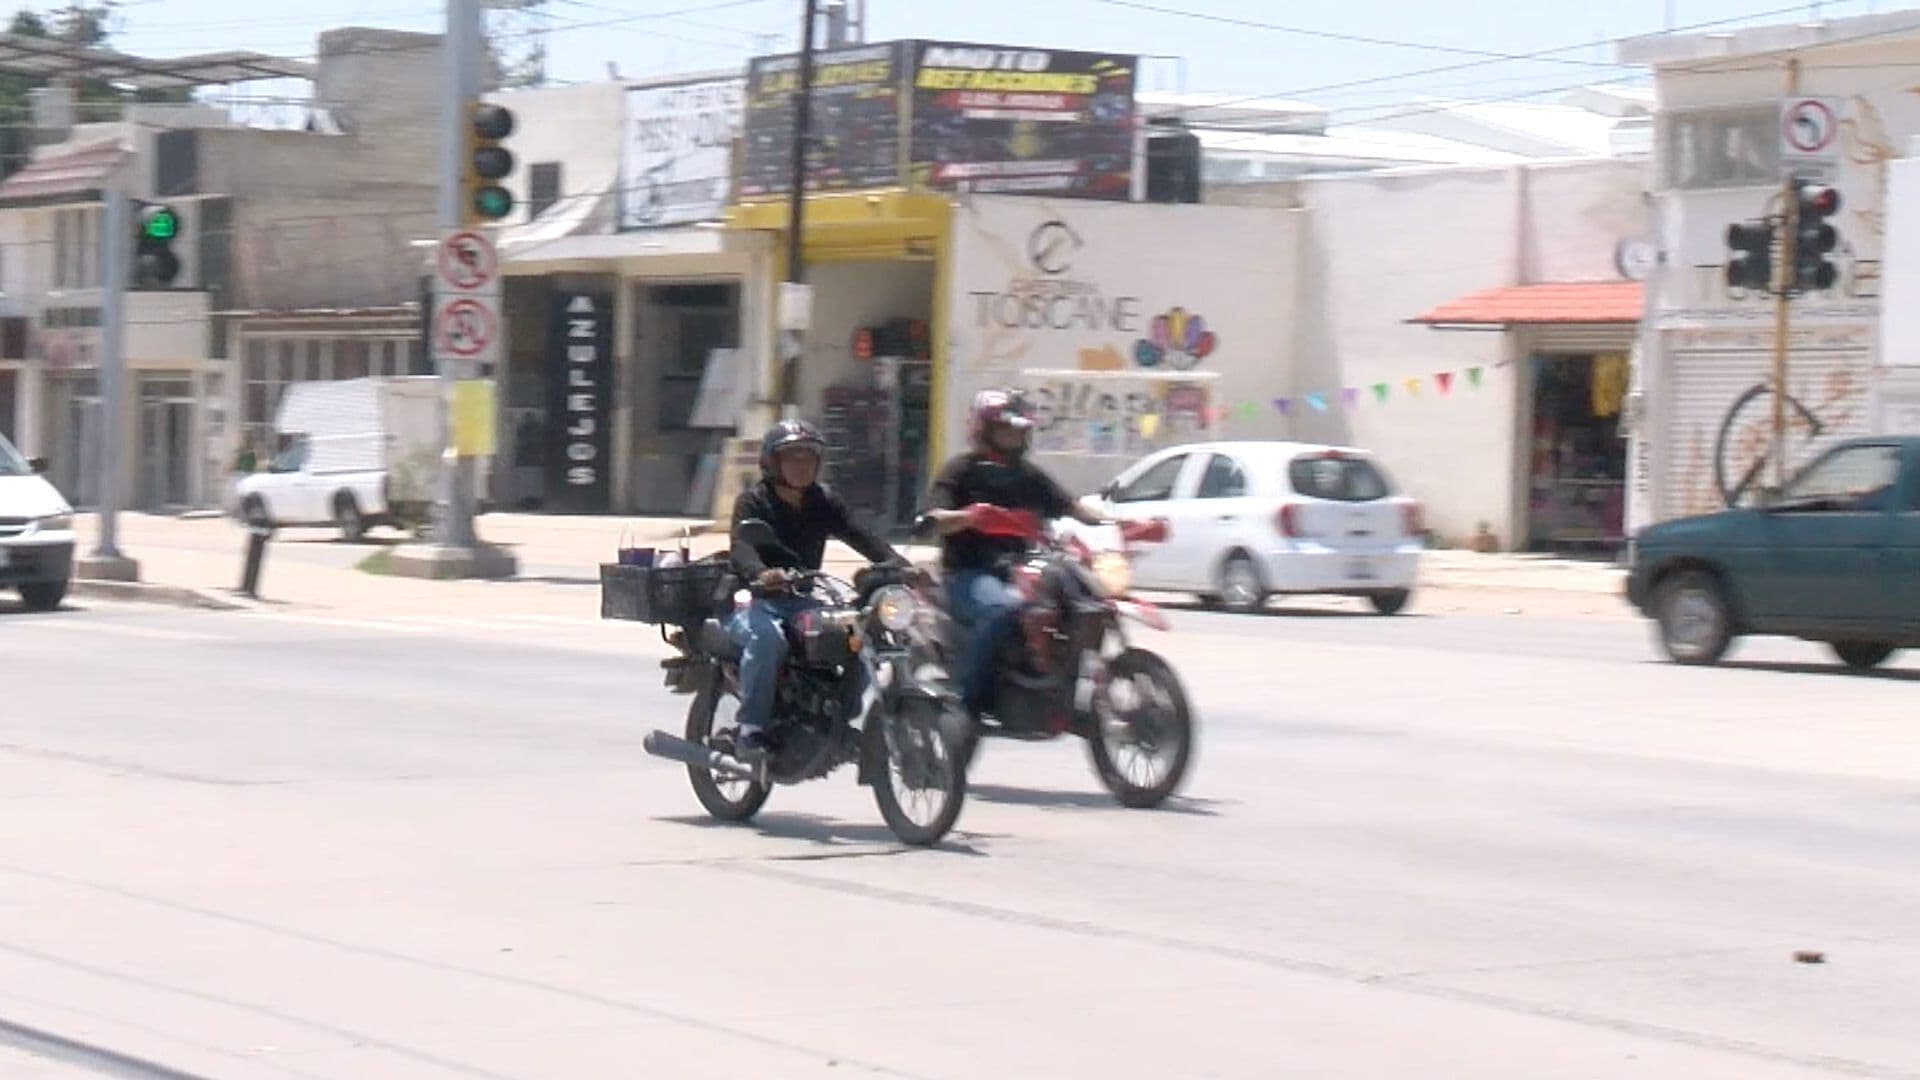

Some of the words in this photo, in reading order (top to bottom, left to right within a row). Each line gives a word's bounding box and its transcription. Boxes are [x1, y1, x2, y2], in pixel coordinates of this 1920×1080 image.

[921, 47, 1050, 71] MOTO
[968, 291, 1140, 333] TOSCANE
[566, 295, 597, 485] AZULEJOS
